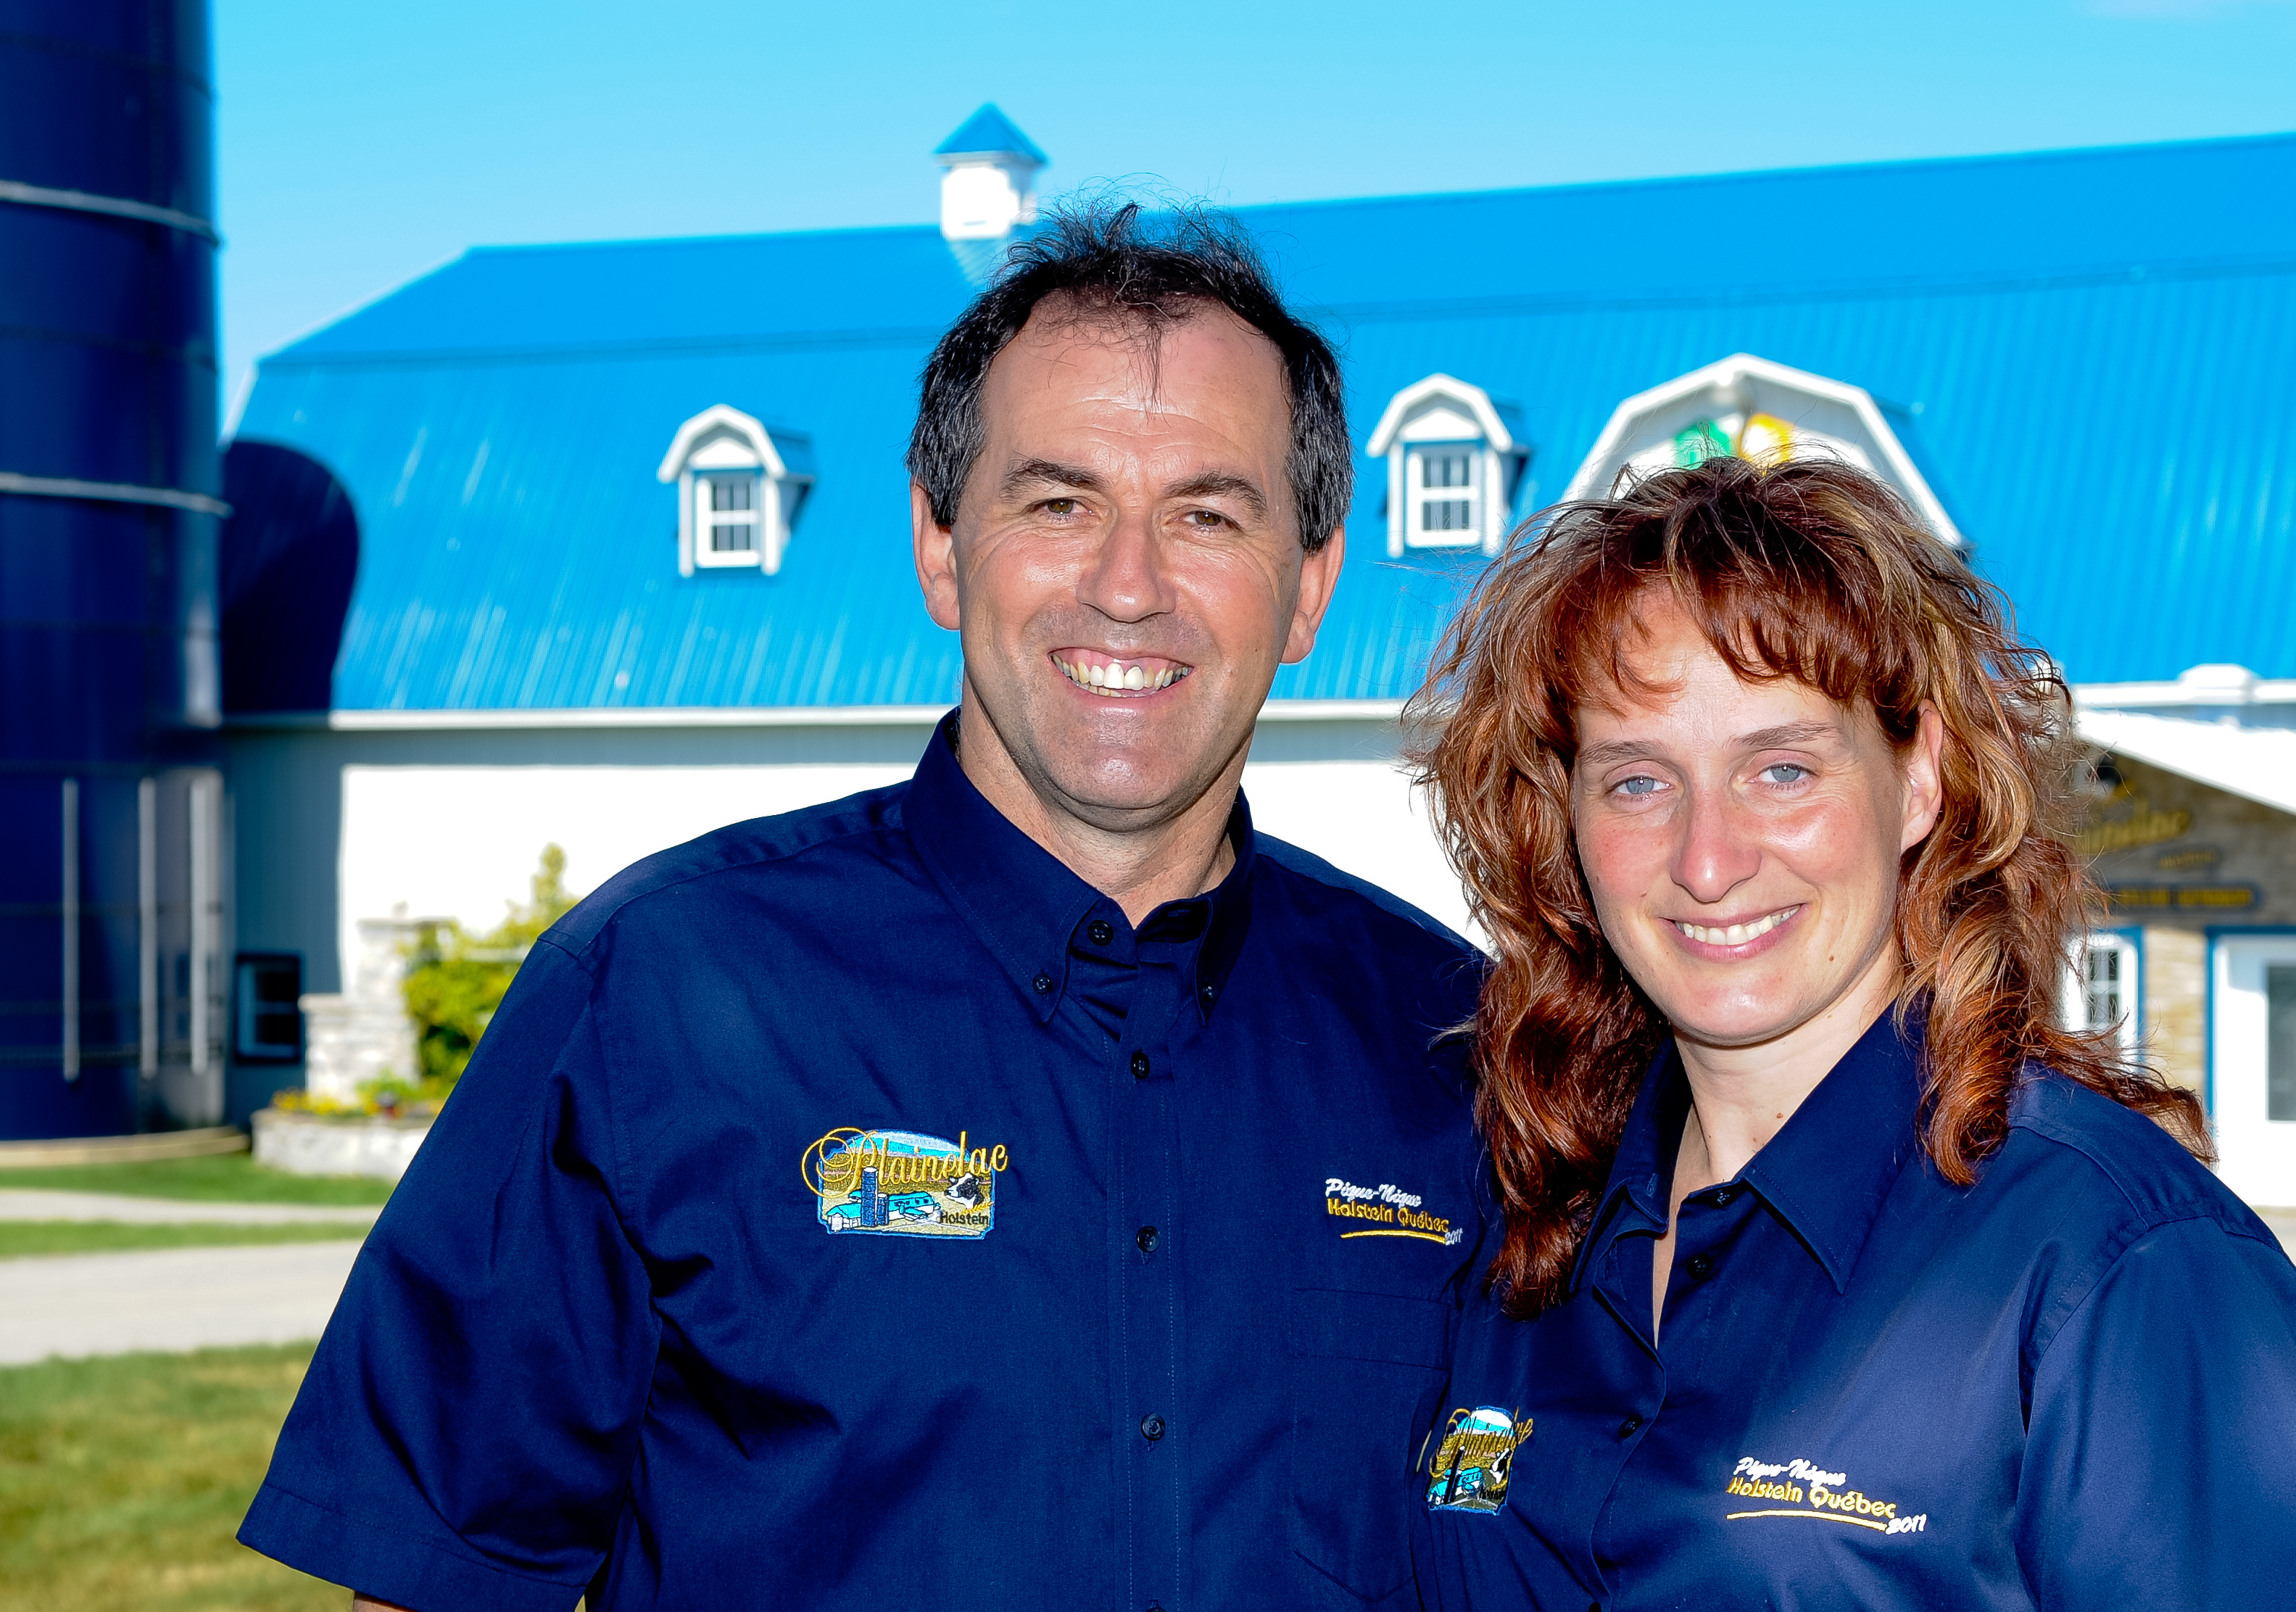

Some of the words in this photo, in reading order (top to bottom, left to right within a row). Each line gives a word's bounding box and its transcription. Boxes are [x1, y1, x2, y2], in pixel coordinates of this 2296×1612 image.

[940, 1210, 990, 1225] Holstein
[1327, 1197, 1394, 1223] Holstein
[1397, 1207, 1450, 1233] Québec
[1725, 1476, 1804, 1504] Holstein
[1808, 1486, 1897, 1519] Québec
[1885, 1513, 1928, 1535] 2011
